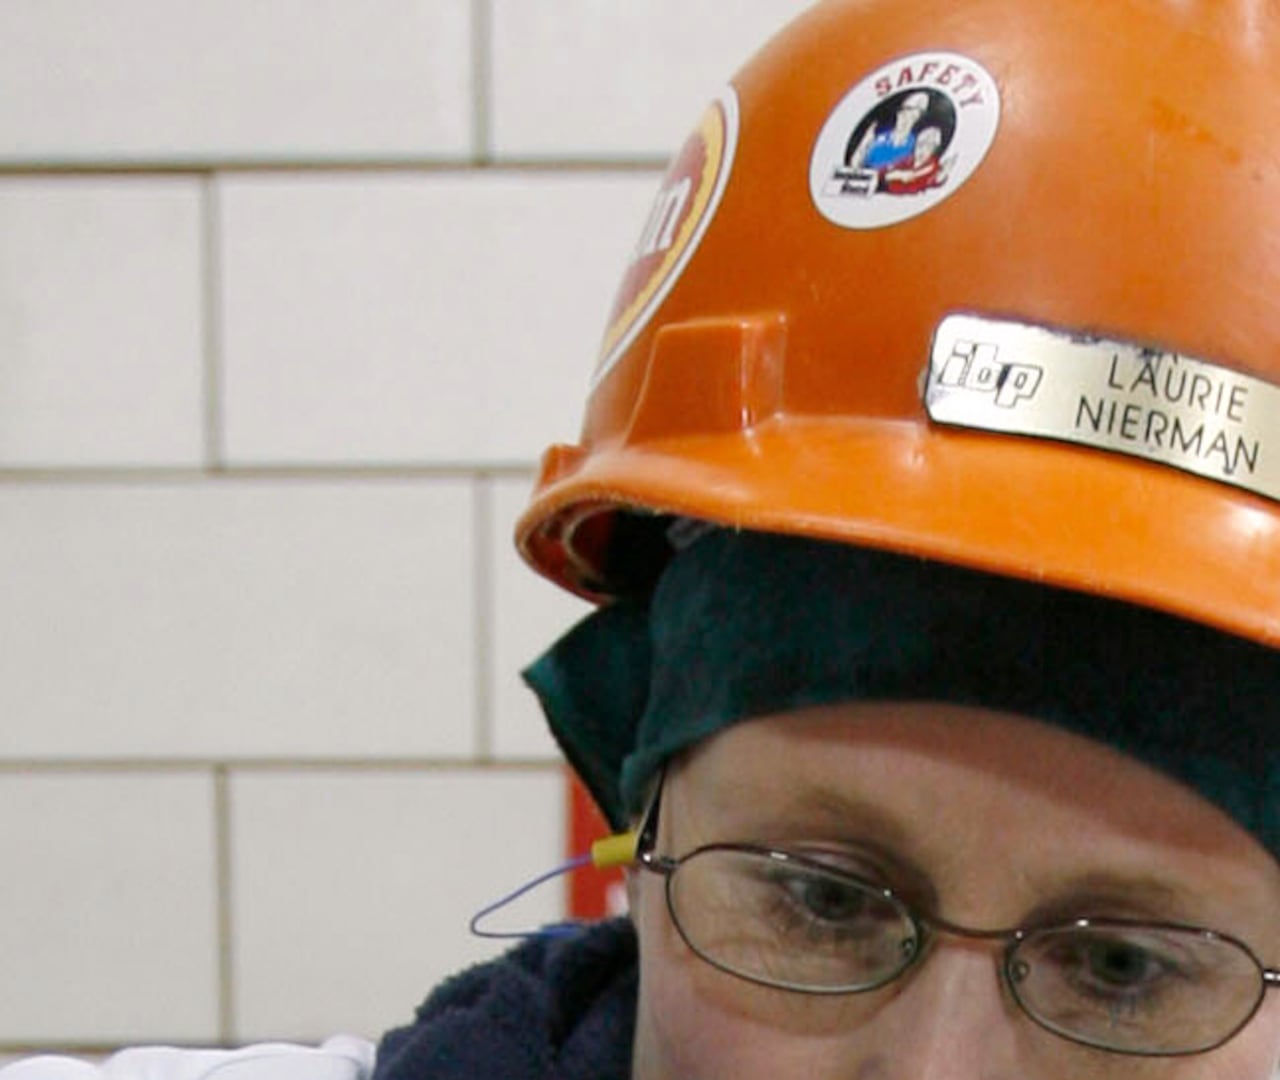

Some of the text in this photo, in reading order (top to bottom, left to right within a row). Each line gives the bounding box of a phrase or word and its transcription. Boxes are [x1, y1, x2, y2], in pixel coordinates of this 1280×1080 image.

[875, 62, 985, 108] SAFETY
[936, 338, 1044, 410] ibp
[1107, 353, 1249, 423] LAURIE
[1075, 394, 1260, 475] NIERMAN
